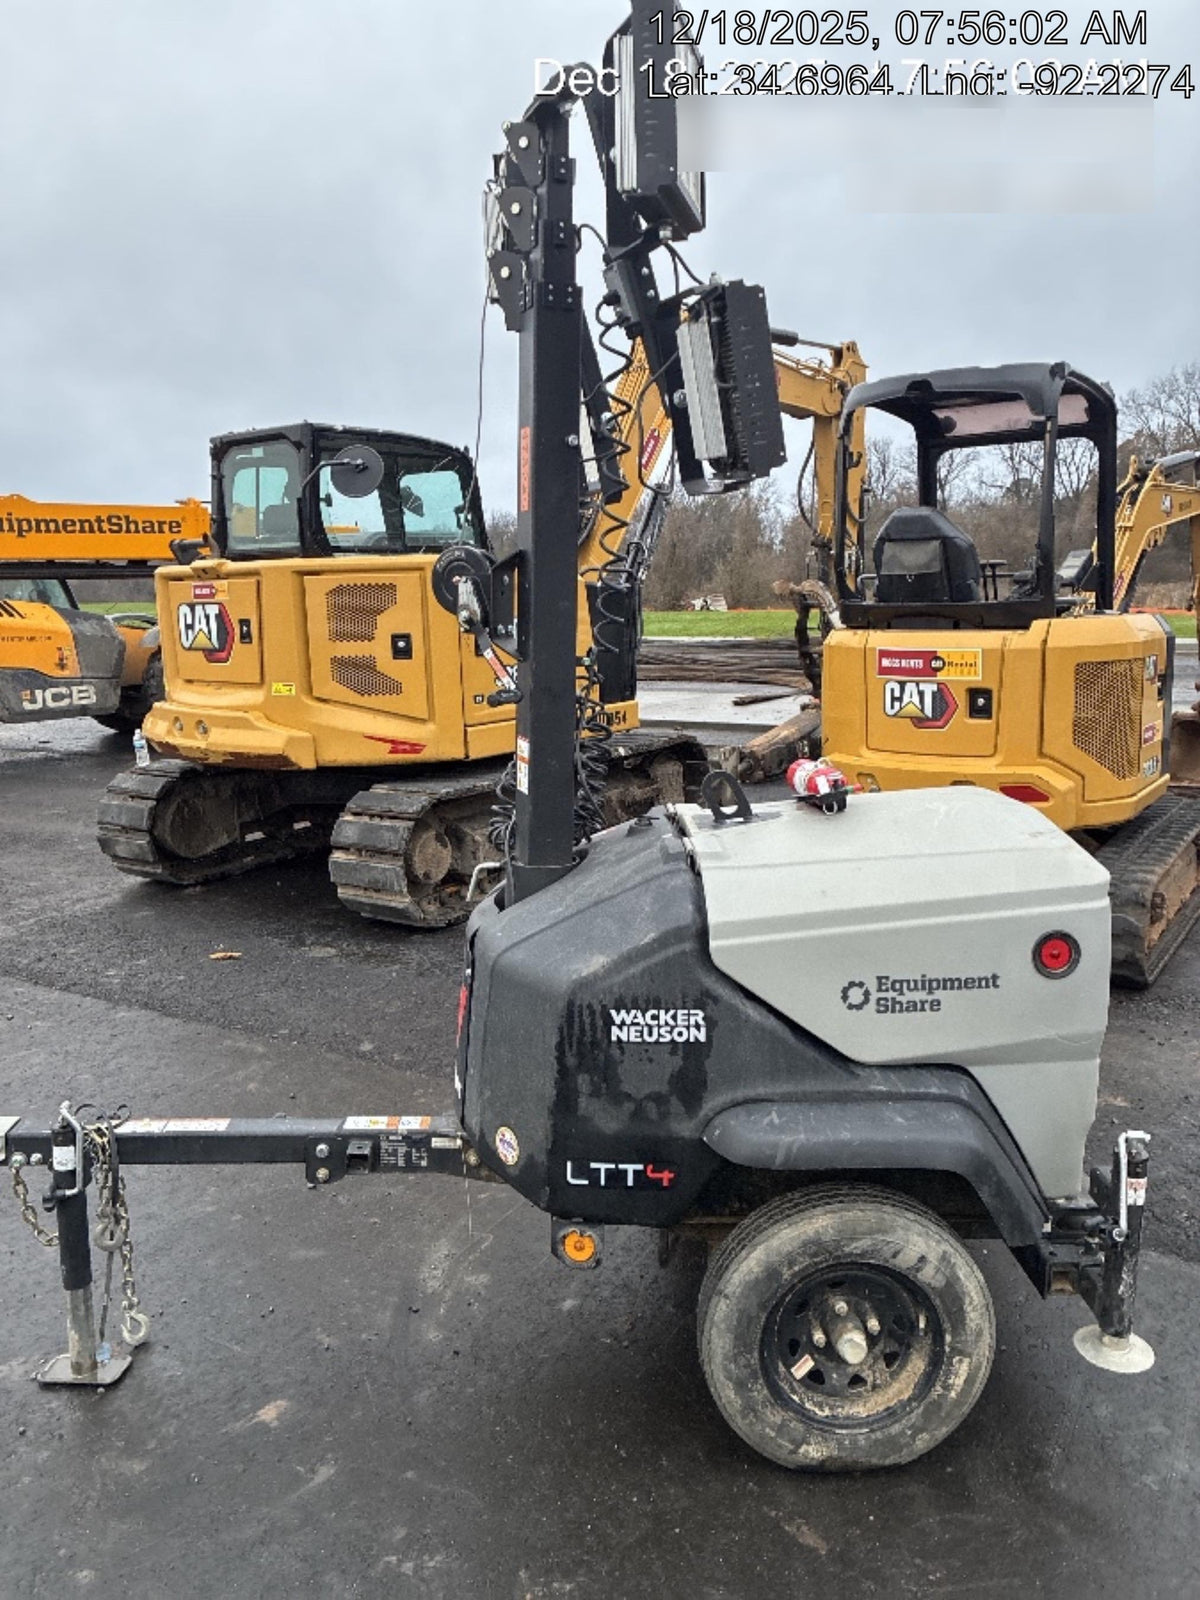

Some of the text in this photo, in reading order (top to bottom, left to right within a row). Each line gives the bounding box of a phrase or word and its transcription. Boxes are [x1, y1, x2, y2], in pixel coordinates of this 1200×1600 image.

[178, 603, 220, 650] CAT
[21, 684, 97, 710] JCB
[884, 681, 938, 718] CAT
[875, 973, 1000, 995] Equipment
[875, 996, 942, 1014] Share
[609, 1009, 705, 1026] WACKER
[611, 1026, 706, 1042] NEUSON
[566, 1160, 675, 1186] LTT4
